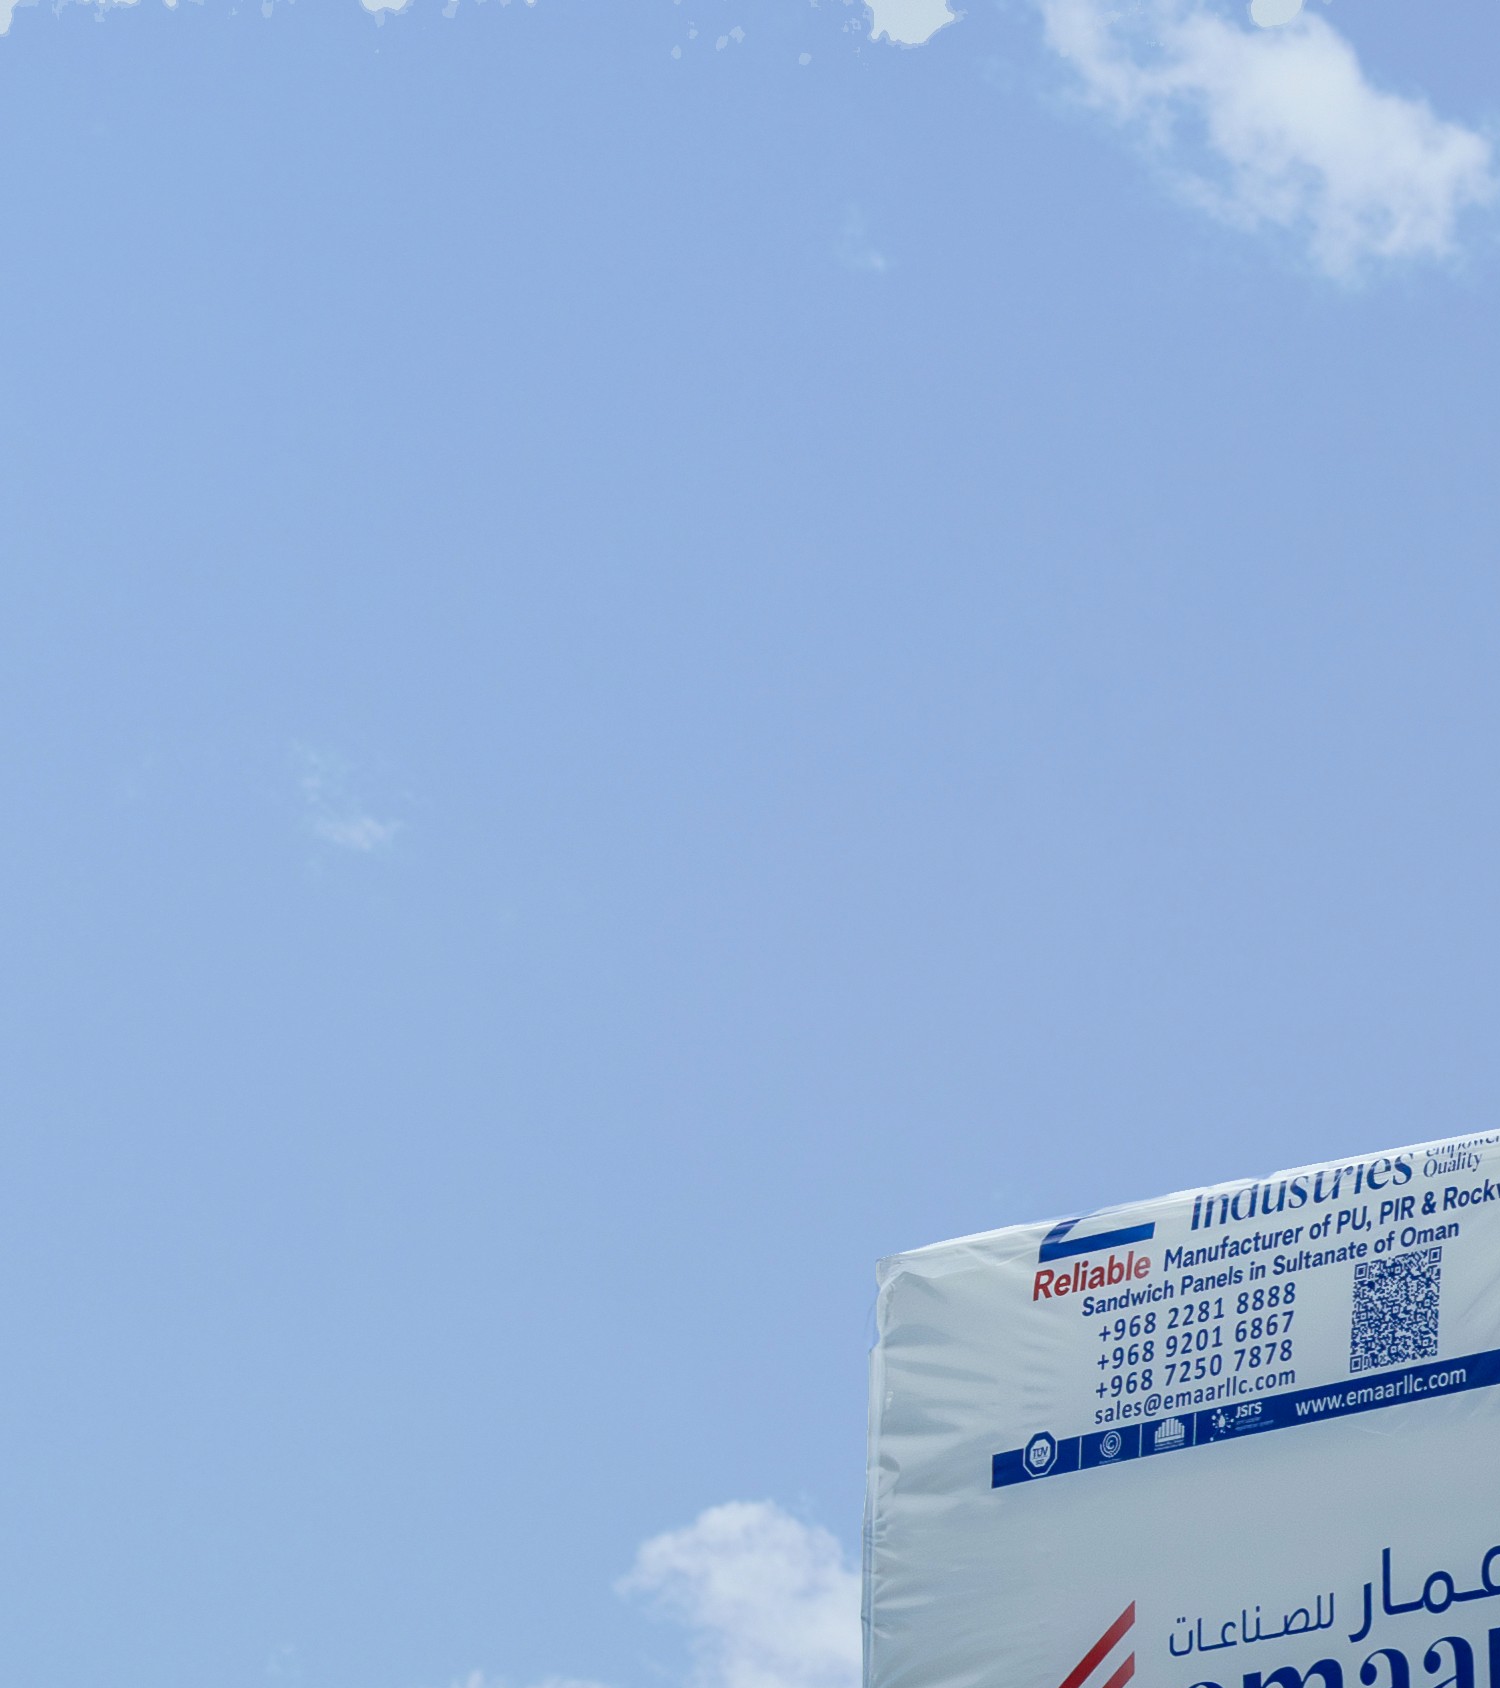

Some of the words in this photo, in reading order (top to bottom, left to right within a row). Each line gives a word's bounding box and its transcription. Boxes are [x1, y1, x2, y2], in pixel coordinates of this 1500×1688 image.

[1423, 1152, 1480, 1177] Quality
[1033, 1251, 1150, 1301] Reliable
[1164, 1226, 1304, 1272] Manufacturer
[1309, 1213, 1332, 1240] of
[1336, 1206, 1372, 1234] PU,
[1379, 1196, 1415, 1225] PIR
[1421, 1191, 1437, 1215] &
[1082, 1280, 1174, 1317] Sandwich
[1180, 1266, 1244, 1296] Panels
[1249, 1261, 1266, 1281] in
[1272, 1241, 1368, 1275] Sultanate
[1374, 1230, 1395, 1254] of
[1400, 1222, 1459, 1247] Oman
[1094, 1370, 1295, 1425] sales@emaarllc.com
[1295, 1368, 1466, 1416] www.emaarllc.com
[1169, 1592, 1334, 1657] للصناعات
